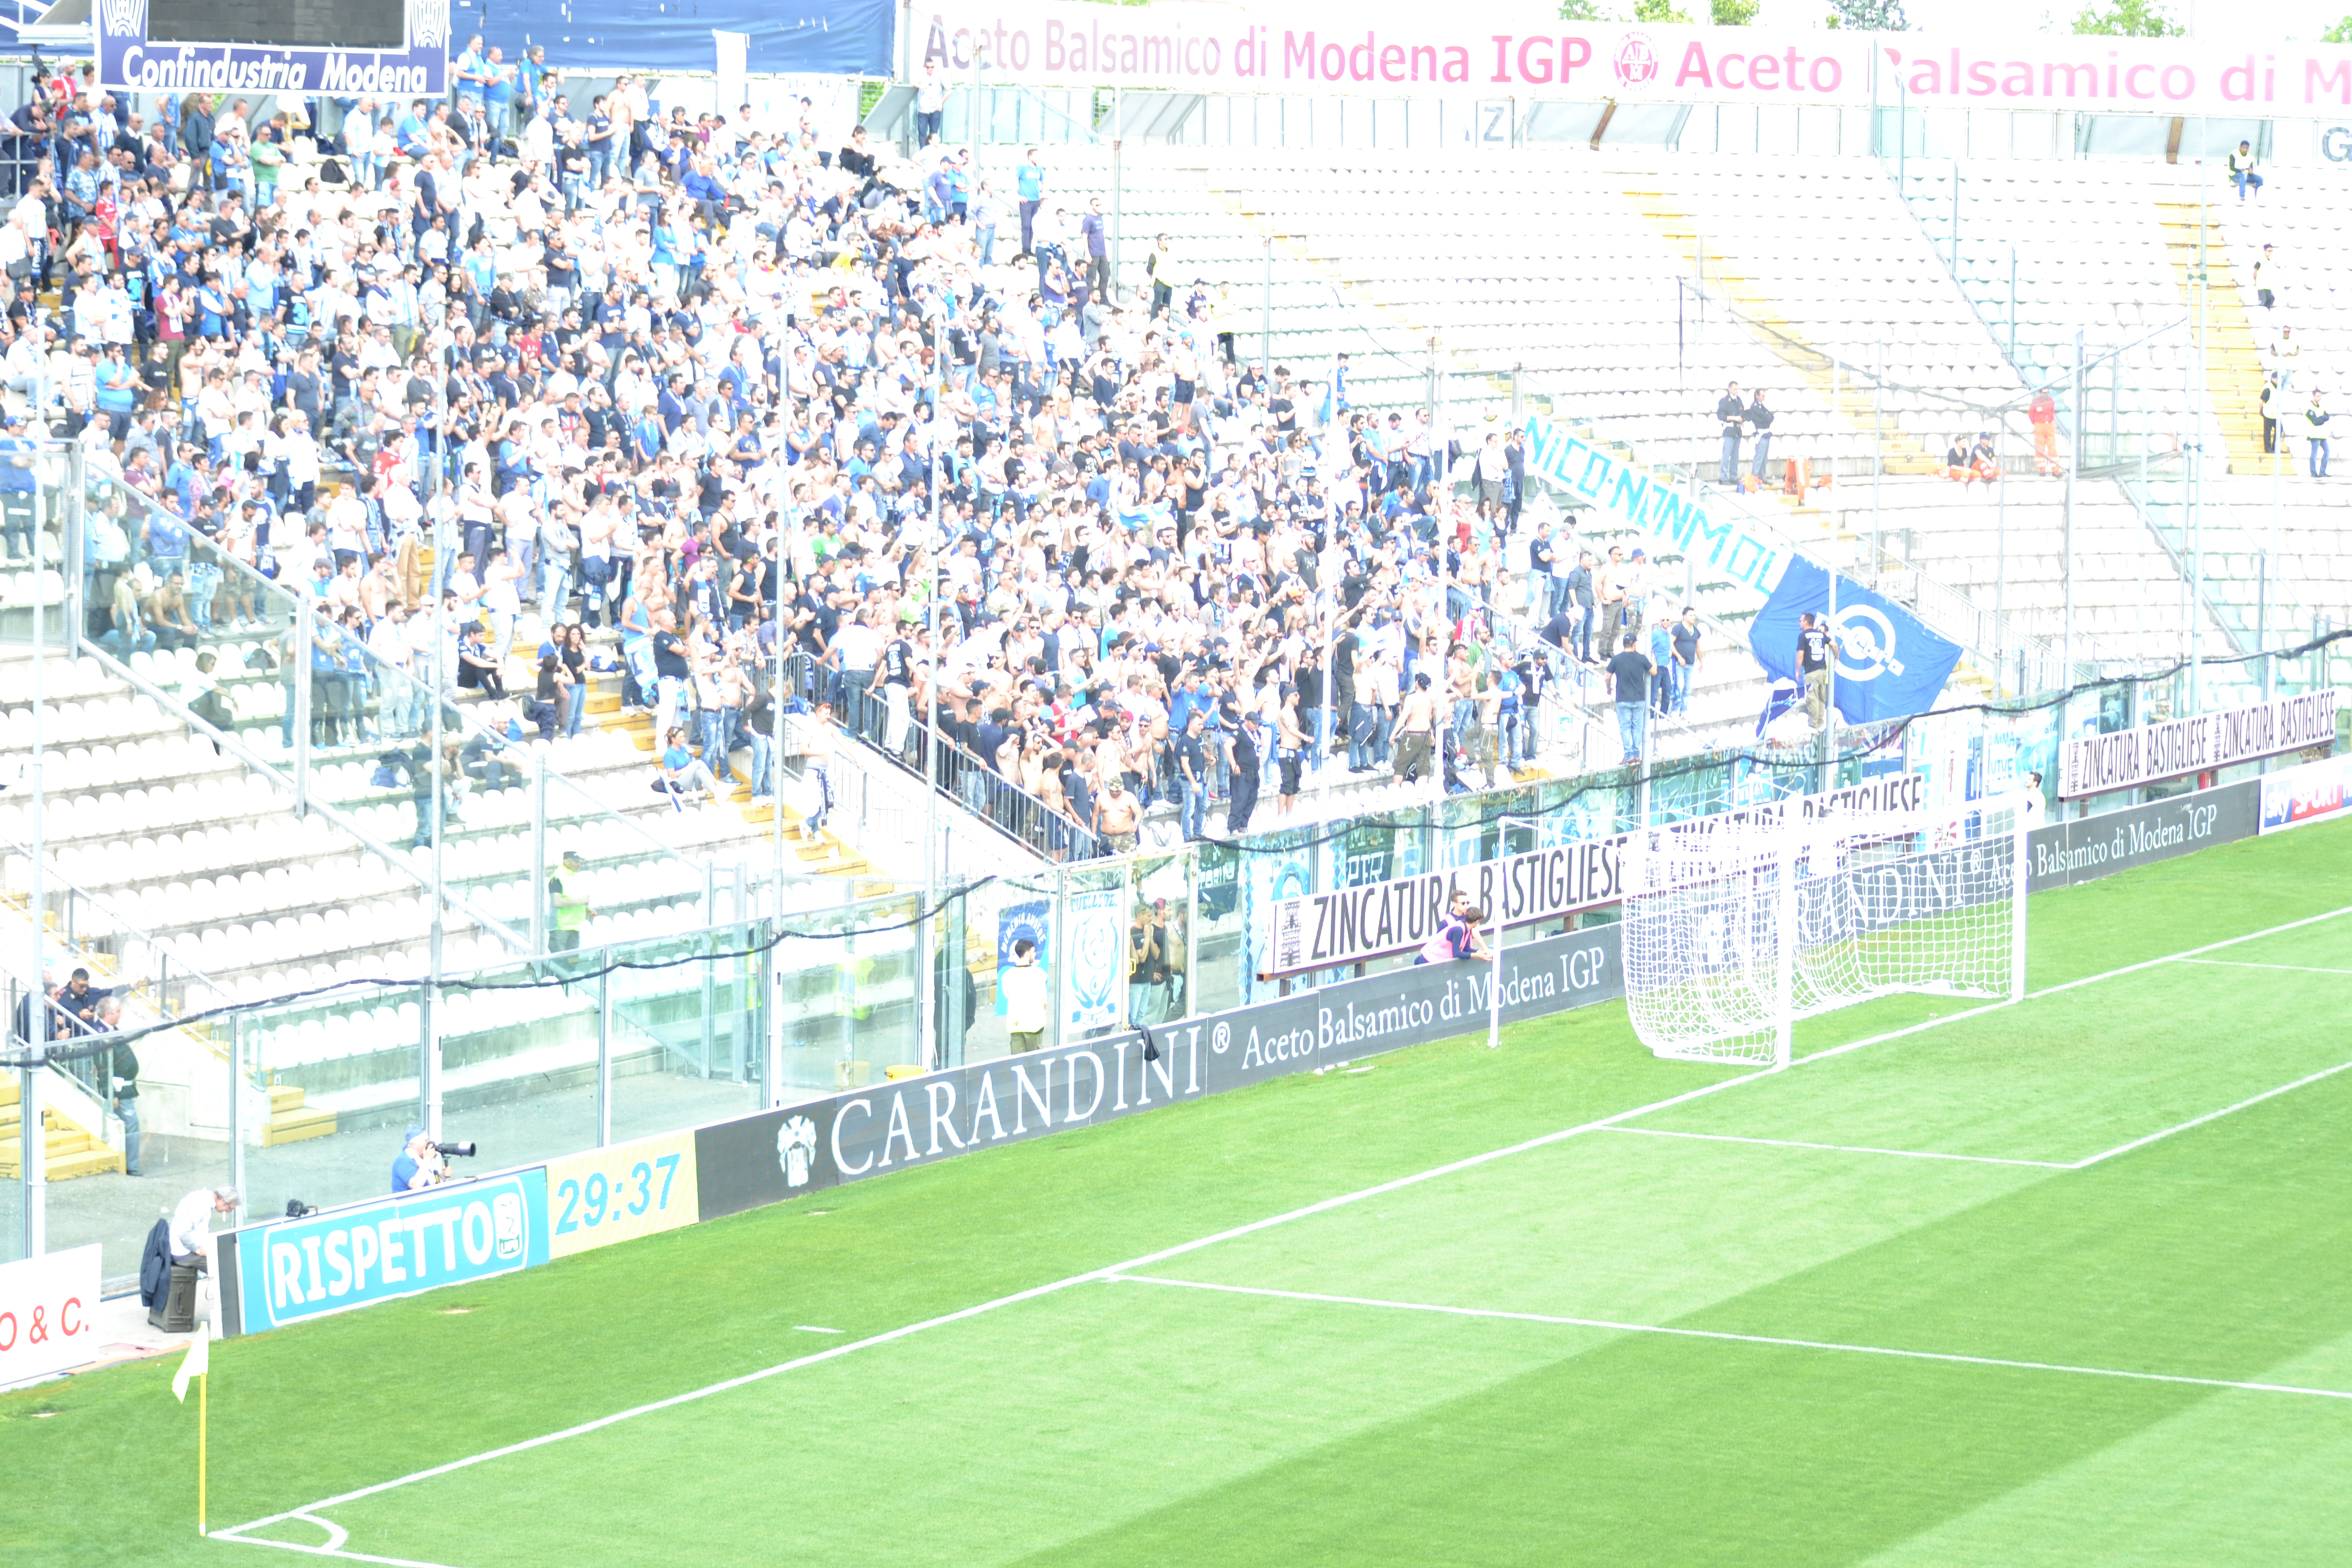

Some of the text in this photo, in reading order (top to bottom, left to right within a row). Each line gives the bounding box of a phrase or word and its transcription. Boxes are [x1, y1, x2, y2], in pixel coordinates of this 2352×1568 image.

[122, 45, 428, 93] Confindustria Modena
[924, 14, 1030, 71] Aceto
[1046, 19, 1220, 76] Balsamico
[1235, 25, 1266, 77] di
[1284, 31, 1469, 83] Modena
[1490, 35, 1592, 85] IGP
[1674, 41, 1842, 92] Aceto
[2219, 54, 2274, 102] di
[2082, 690, 2335, 790] ZINCATURA BASTIGLIESE ZINCATURA BASTIGLIESE
[2266, 783, 2291, 823] sky
[2294, 779, 2340, 814] SPORT
[1989, 853, 2032, 888] Aco
[2037, 837, 2108, 877] Balsamico
[2112, 830, 2124, 857] di
[2129, 820, 2184, 855] Modena
[2187, 804, 2218, 841] IGP
[1312, 871, 1460, 960] ZINCATURA
[1480, 836, 1627, 926] BASTIGLIESE
[1242, 1026, 1314, 1069] Aceto
[1319, 993, 1433, 1048] Balsamico
[1440, 979, 1462, 1020] di
[1467, 966, 1555, 1014] Modena
[1560, 946, 1604, 993] IGP
[555, 1154, 680, 1235] 29:37
[272, 1201, 494, 1309] RISPETTO
[30, 1305, 48, 1344] &
[61, 1297, 90, 1337] C.
